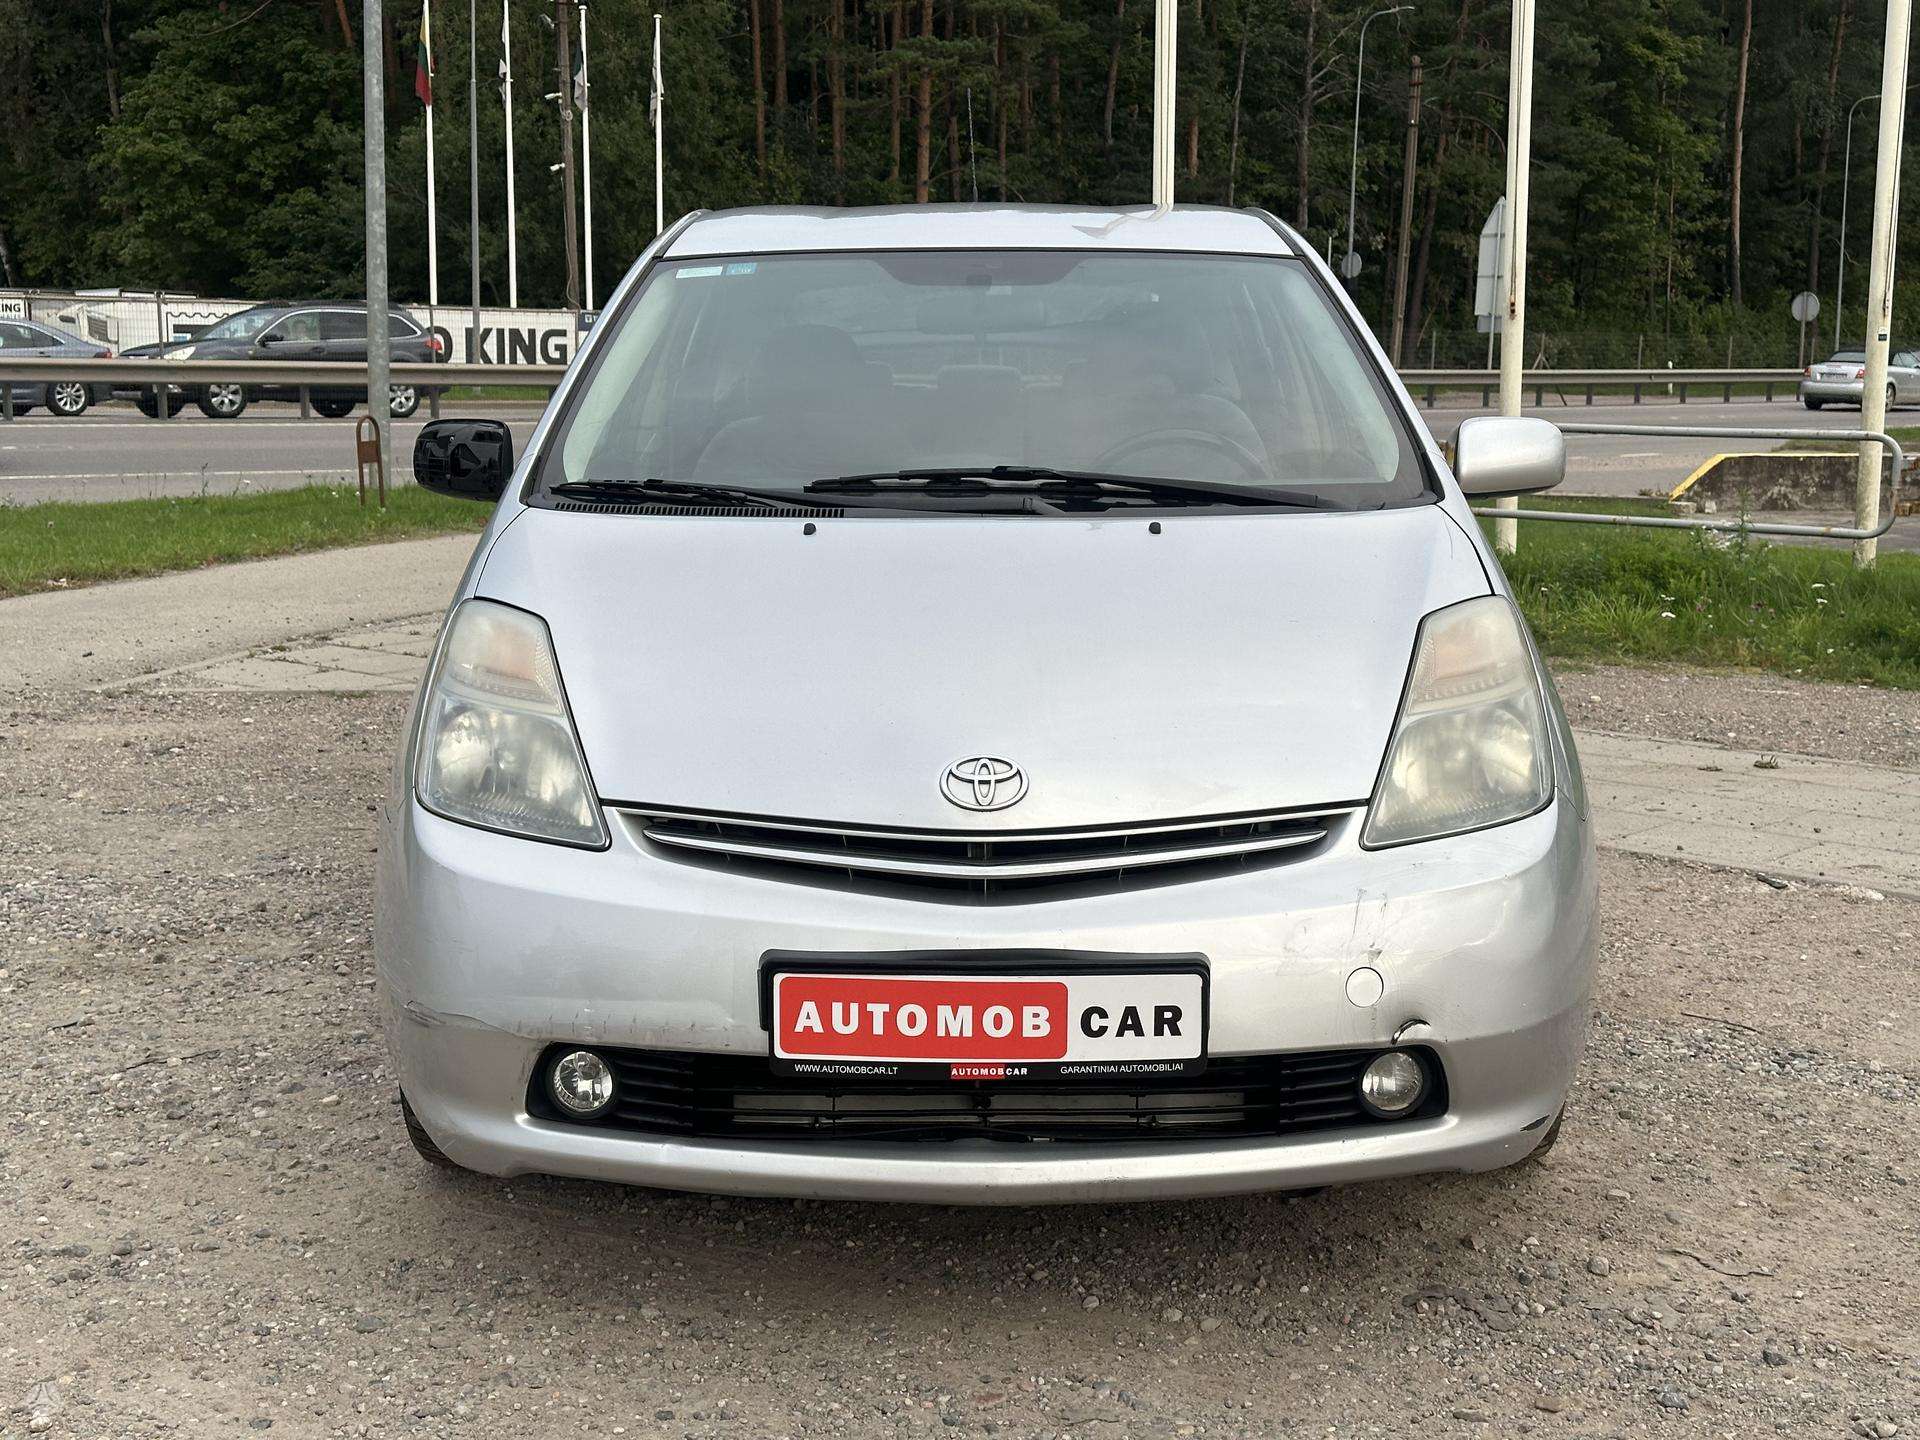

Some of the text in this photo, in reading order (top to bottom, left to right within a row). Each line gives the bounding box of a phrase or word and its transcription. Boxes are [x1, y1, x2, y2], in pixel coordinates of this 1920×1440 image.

[0, 303, 21, 312] ING
[465, 327, 568, 365] KING
[794, 1001, 1183, 1038] AUTOMOB CAR
[794, 1064, 898, 1075] WWW.AUTOMOBCAR.LT
[1060, 1063, 1184, 1074] GARANTINIAI AUTOMOBILIAI
